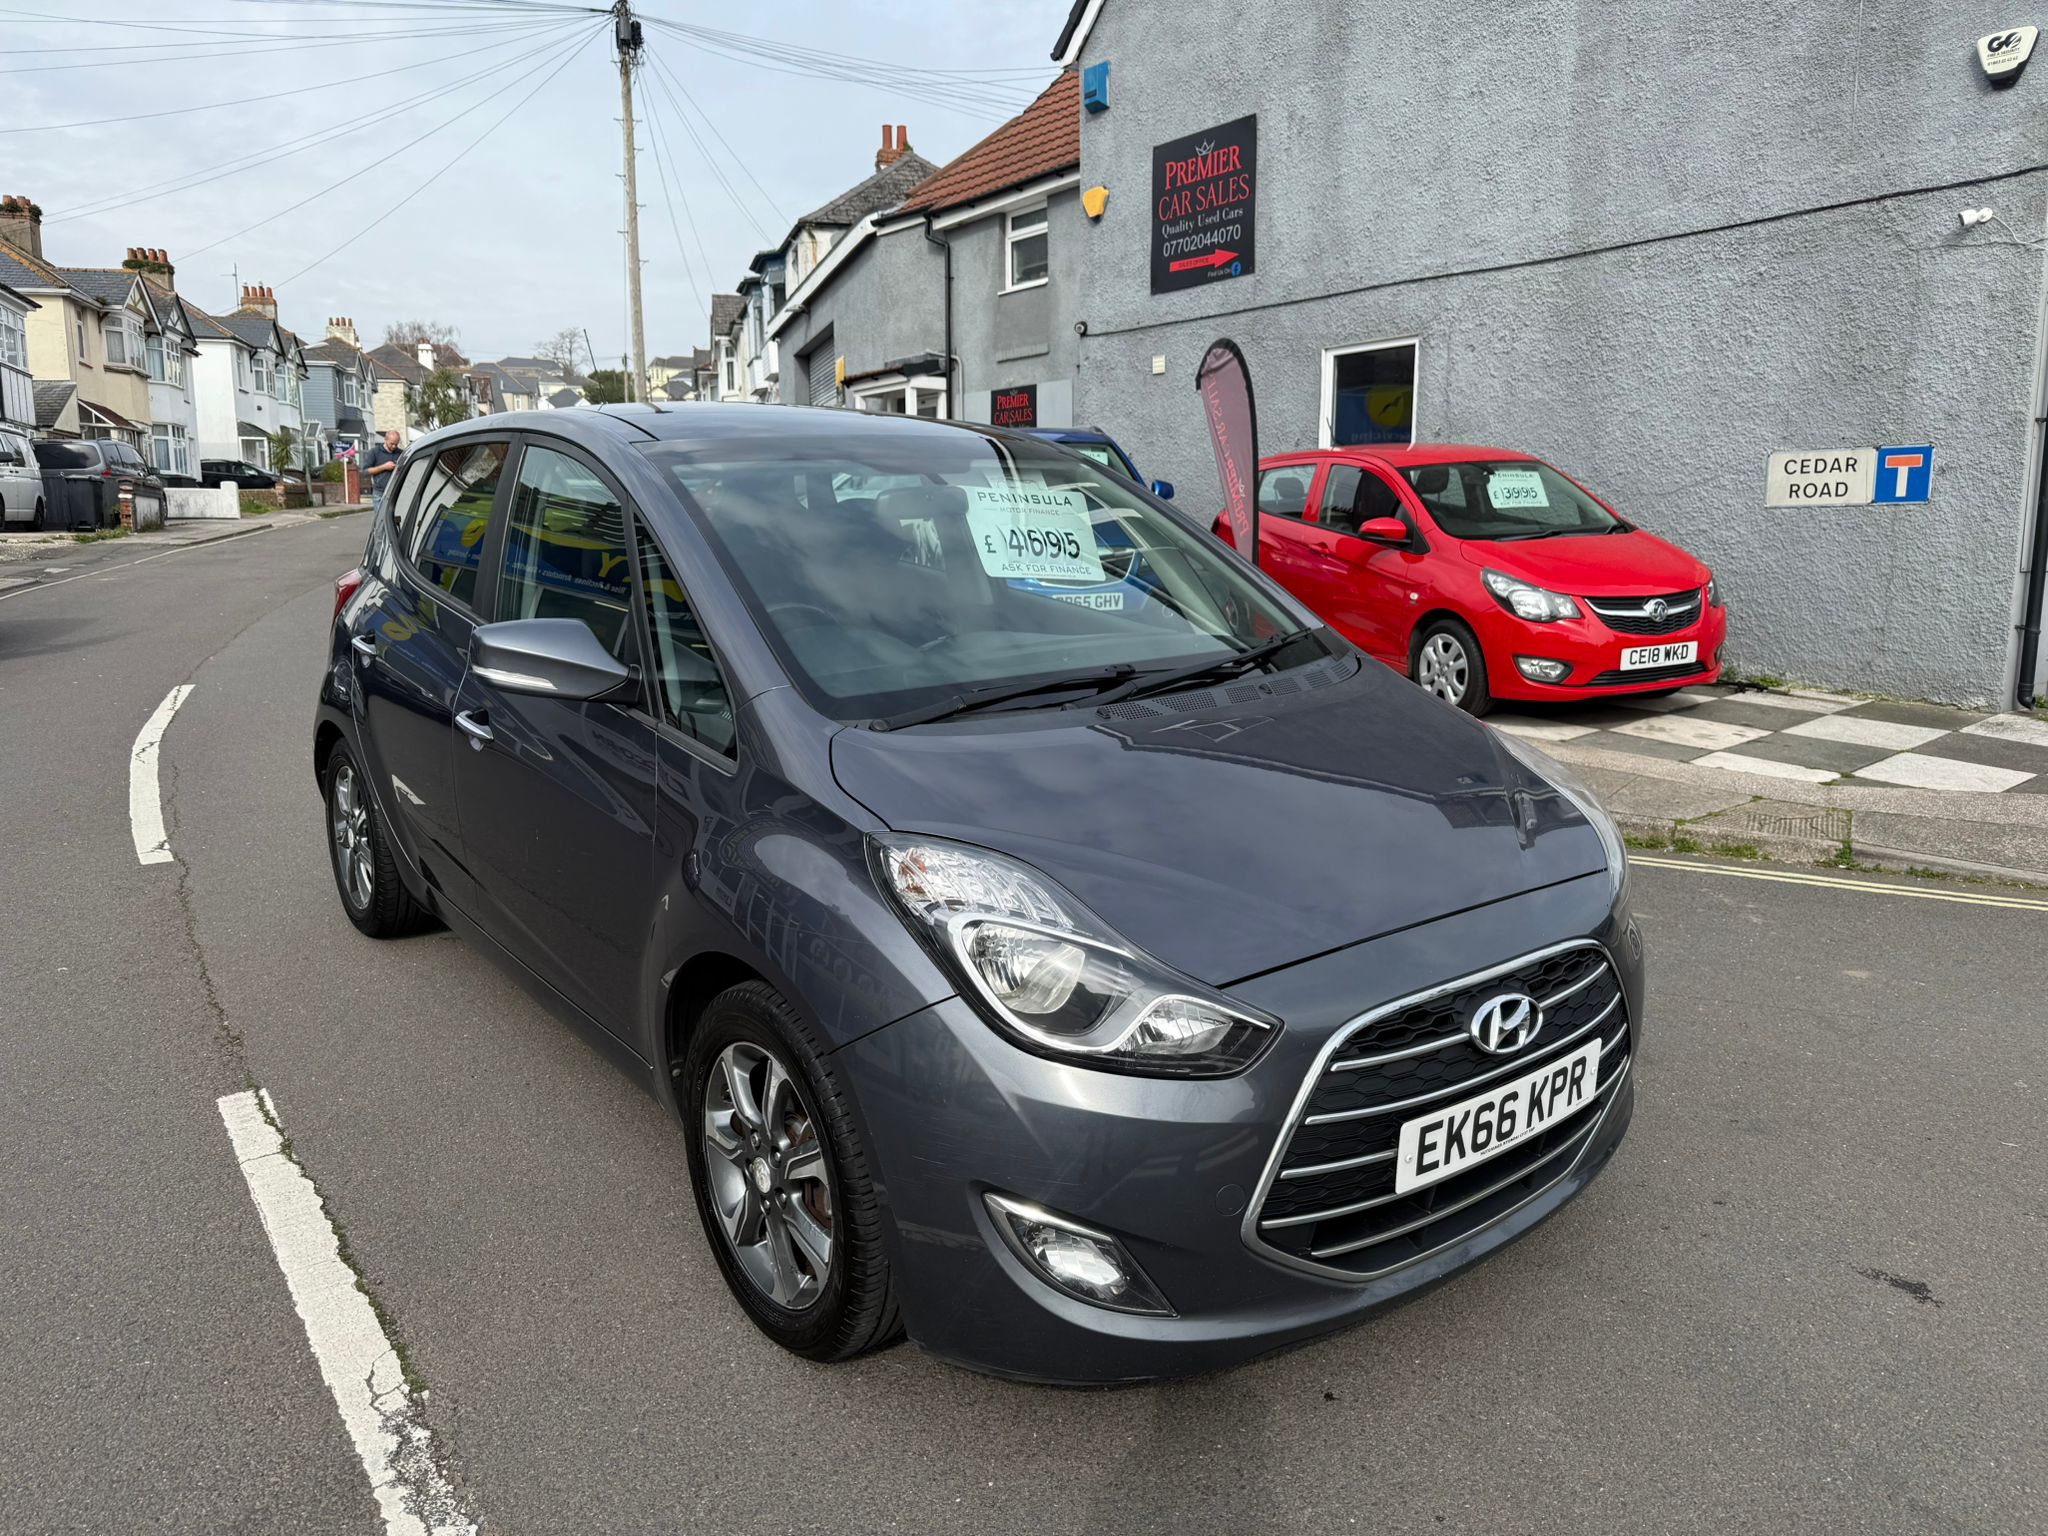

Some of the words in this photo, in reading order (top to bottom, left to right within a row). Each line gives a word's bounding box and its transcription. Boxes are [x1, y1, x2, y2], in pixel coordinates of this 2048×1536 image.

[1165, 145, 1242, 190] PREMIER
[1159, 190, 1192, 221] CAR
[1196, 174, 1250, 211] SALES
[1162, 219, 1195, 239] Quality
[1198, 212, 1220, 228] Used
[1222, 206, 1244, 221] Cars
[1163, 224, 1241, 257] 07702044070
[997, 392, 1028, 410] PREMIER
[994, 412, 1009, 425] CAR
[1010, 407, 1033, 423] SALES
[1784, 457, 1858, 475] CEDAR
[977, 491, 1073, 506] PENINSULA
[1503, 487, 1538, 499] 3995
[1789, 481, 1849, 499] ROAD
[1028, 508, 1060, 516] FINANCE
[984, 534, 997, 554] £
[1008, 529, 1080, 559] 4695
[1002, 563, 1023, 572] ASK
[1026, 563, 1047, 573] FOR
[1050, 565, 1092, 575] FINANCE
[1095, 594, 1121, 609] GHV
[1629, 647, 1660, 665] CE18
[1663, 643, 1689, 662] WKD
[1415, 1090, 1519, 1176] EK66
[1526, 1055, 1587, 1129] KPR
